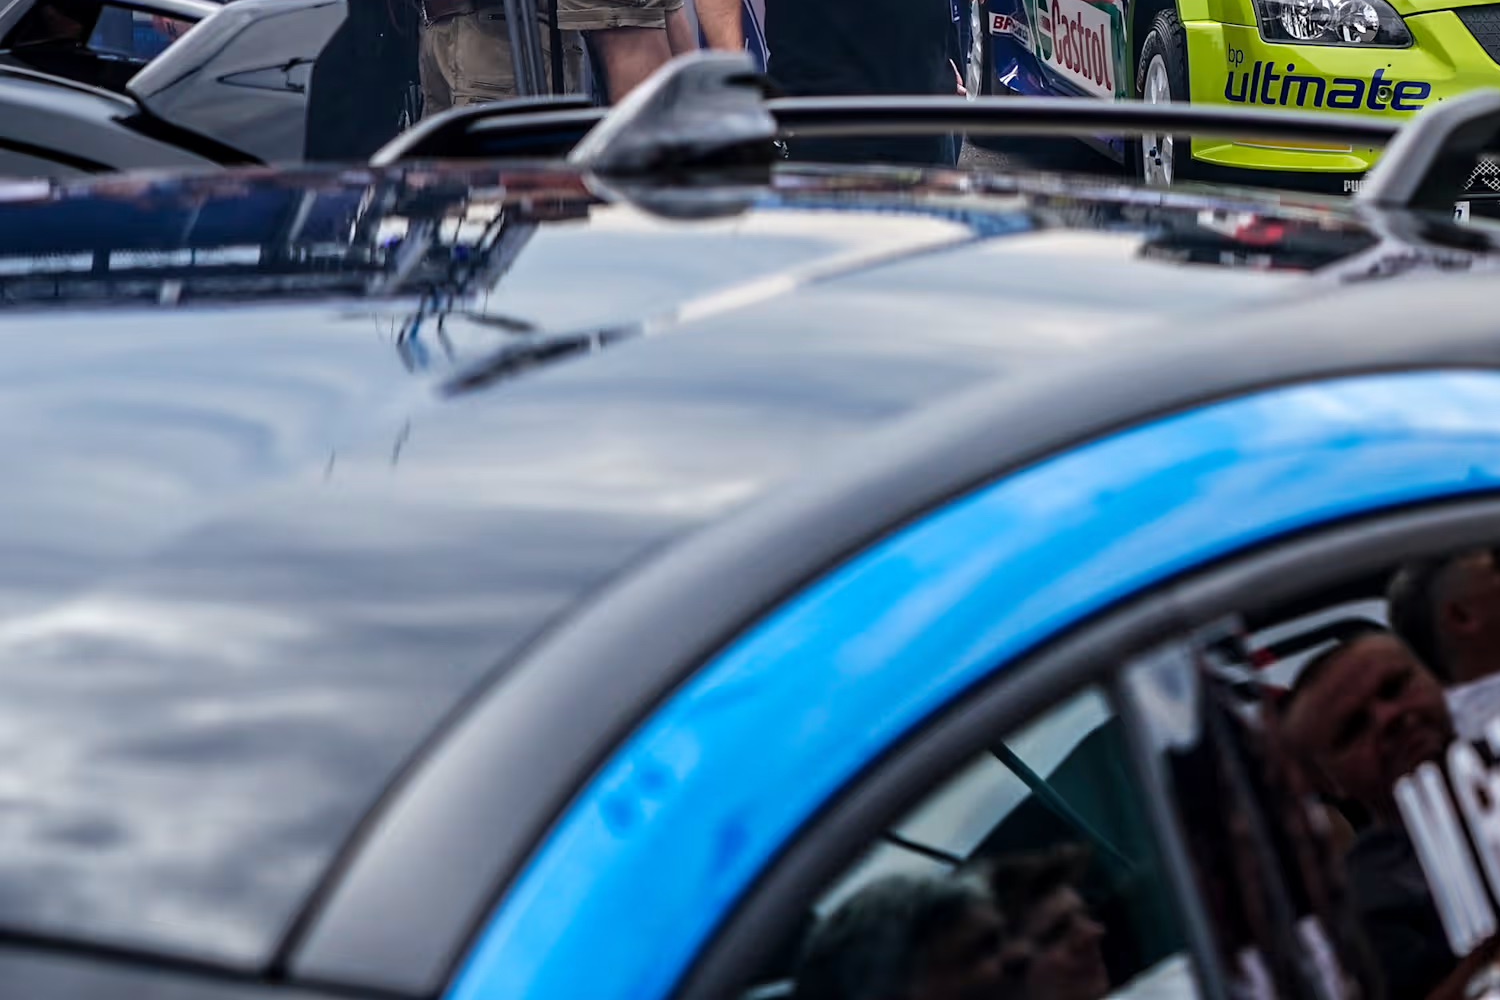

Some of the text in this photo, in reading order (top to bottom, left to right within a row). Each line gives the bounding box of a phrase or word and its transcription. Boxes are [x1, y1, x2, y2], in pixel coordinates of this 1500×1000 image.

[1228, 43, 1244, 67] bp
[1224, 60, 1432, 111] ultimate
[1343, 179, 1367, 193] PU
